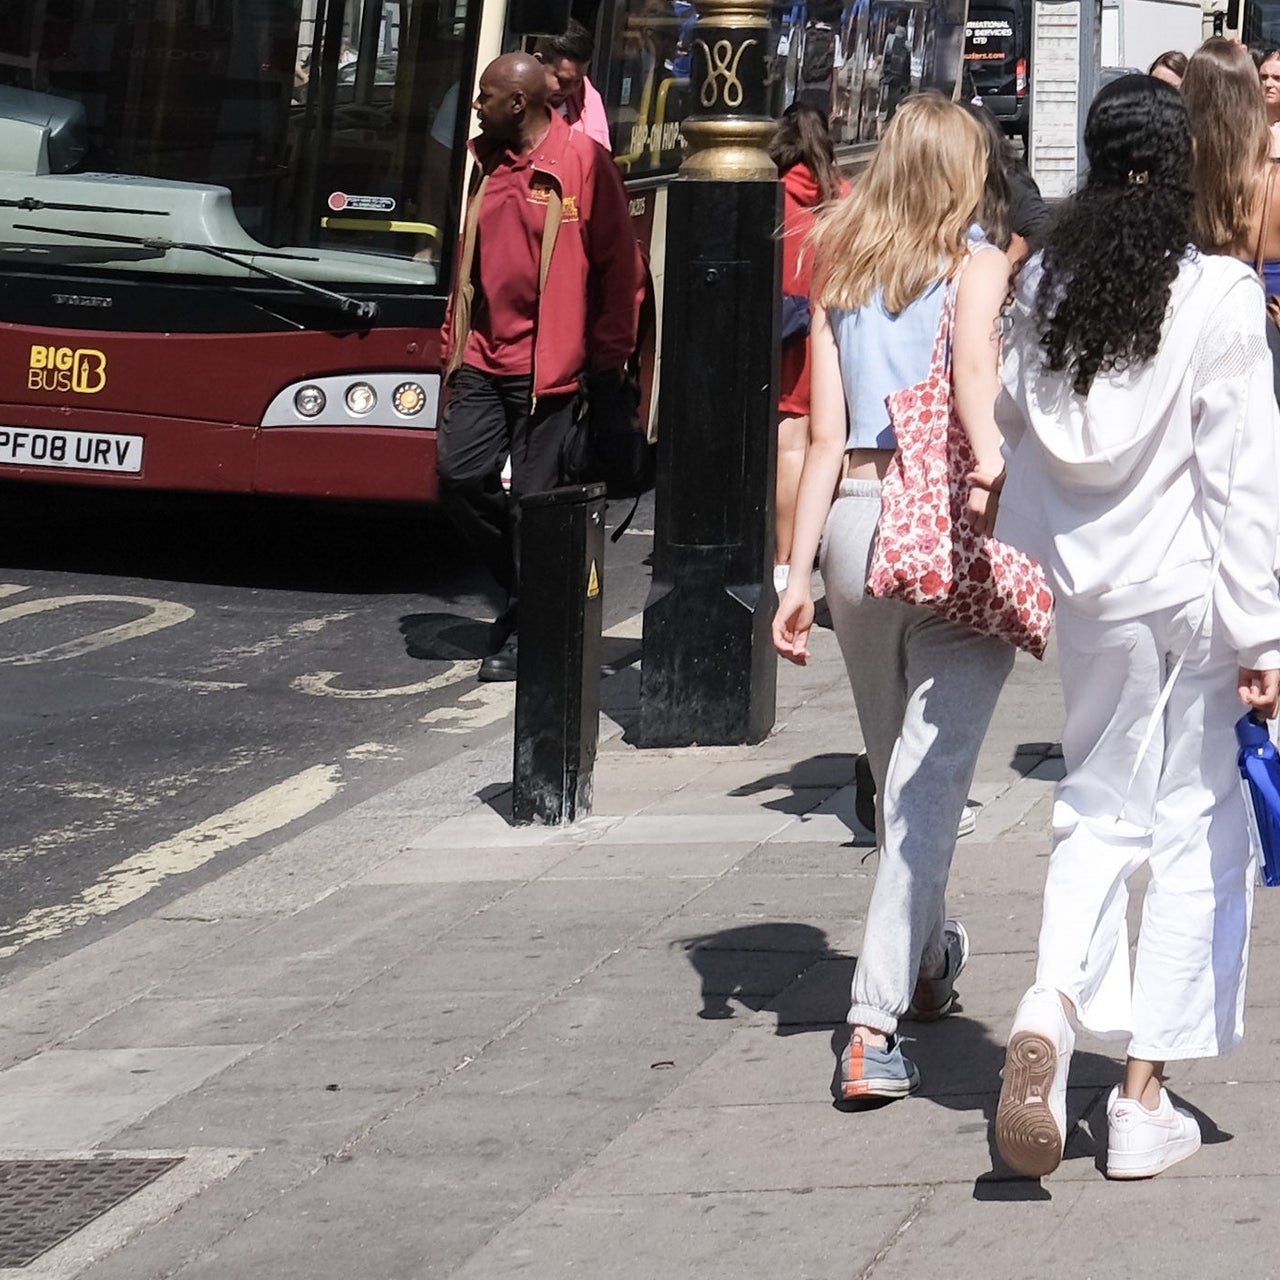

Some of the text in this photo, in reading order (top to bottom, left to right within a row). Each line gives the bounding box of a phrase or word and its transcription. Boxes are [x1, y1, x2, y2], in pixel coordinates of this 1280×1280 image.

[30, 345, 74, 371] BIG
[27, 368, 71, 392] BUS
[75, 436, 131, 466] URV
